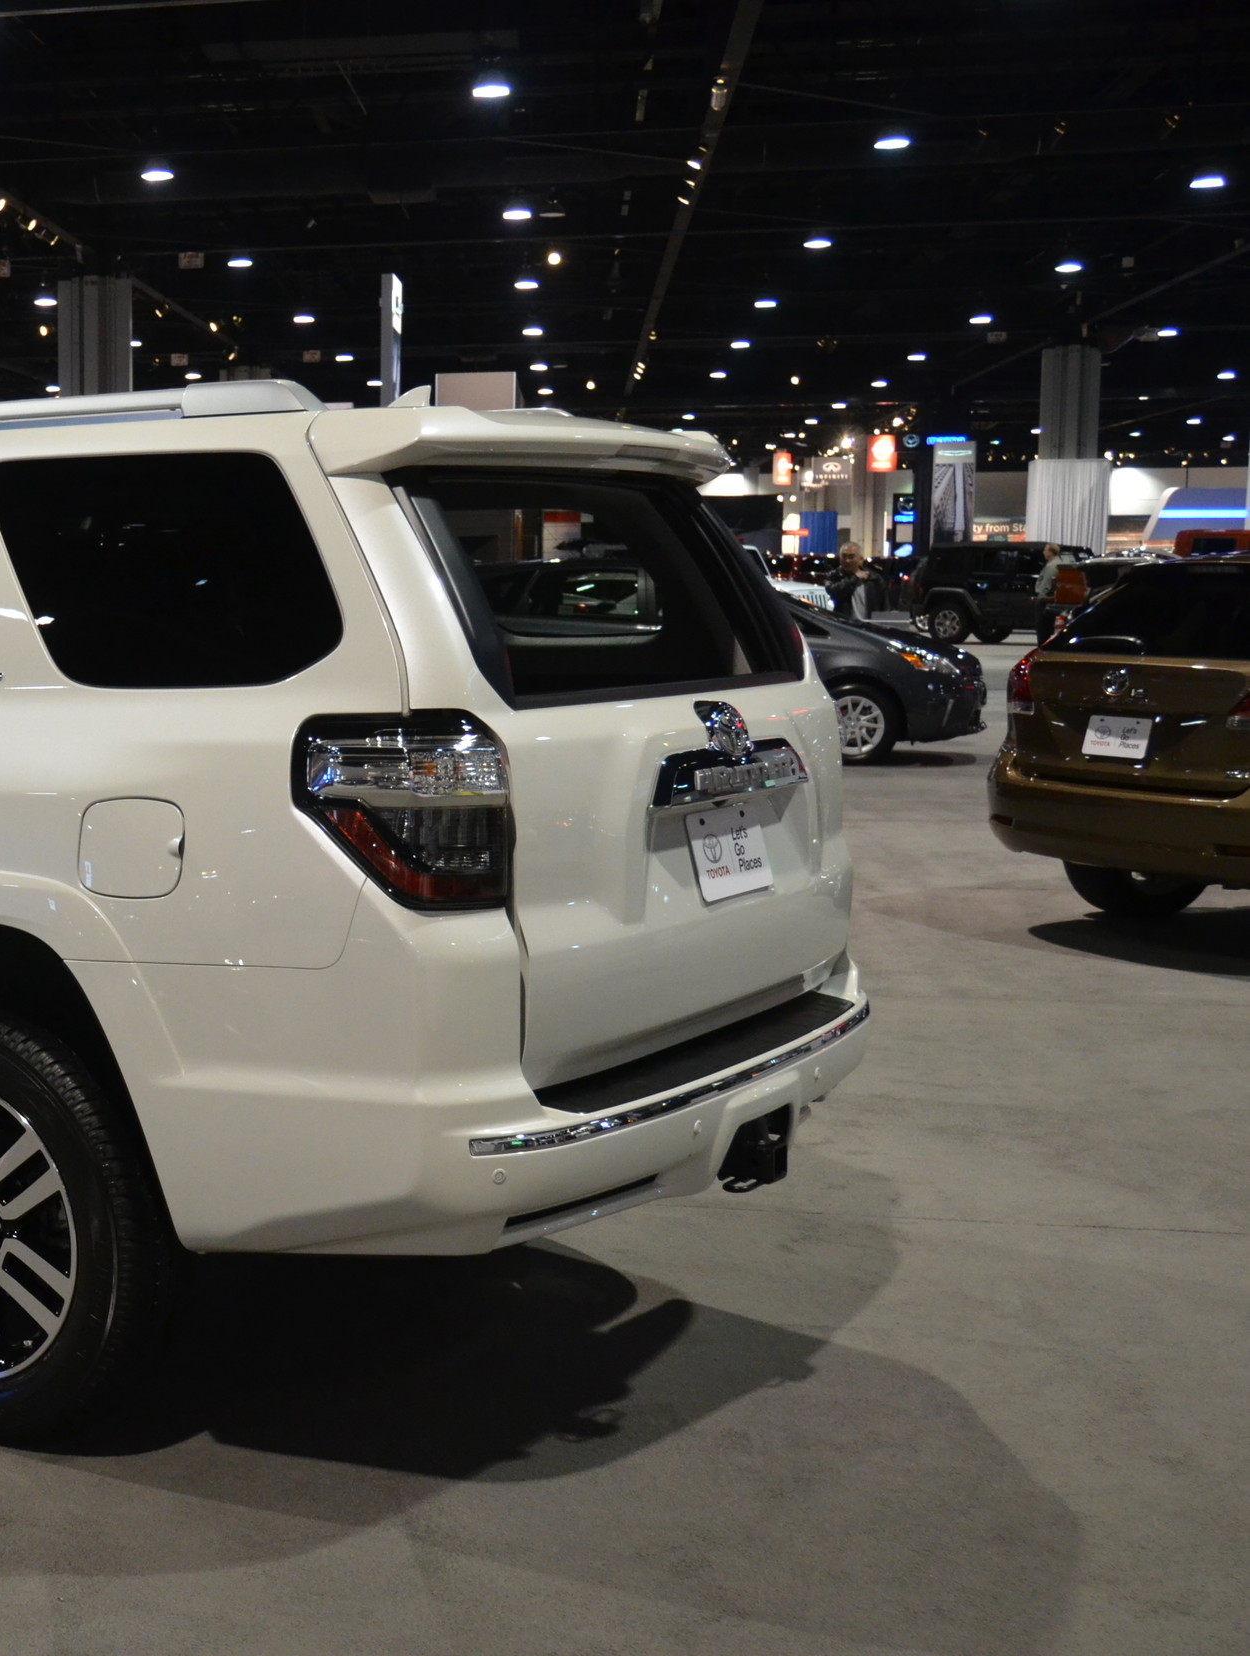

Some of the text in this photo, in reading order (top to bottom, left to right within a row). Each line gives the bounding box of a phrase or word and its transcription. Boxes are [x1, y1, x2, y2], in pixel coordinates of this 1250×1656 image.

[985, 523, 1010, 532] from
[1122, 726, 1138, 734] Let's
[1120, 733, 1130, 741] Go
[1090, 739, 1110, 747] TOYOTA
[1118, 740, 1140, 750] Places
[730, 825, 748, 841] Let's
[734, 842, 745, 856] Go
[738, 856, 763, 872] Places
[706, 865, 731, 880] TOYOTA
